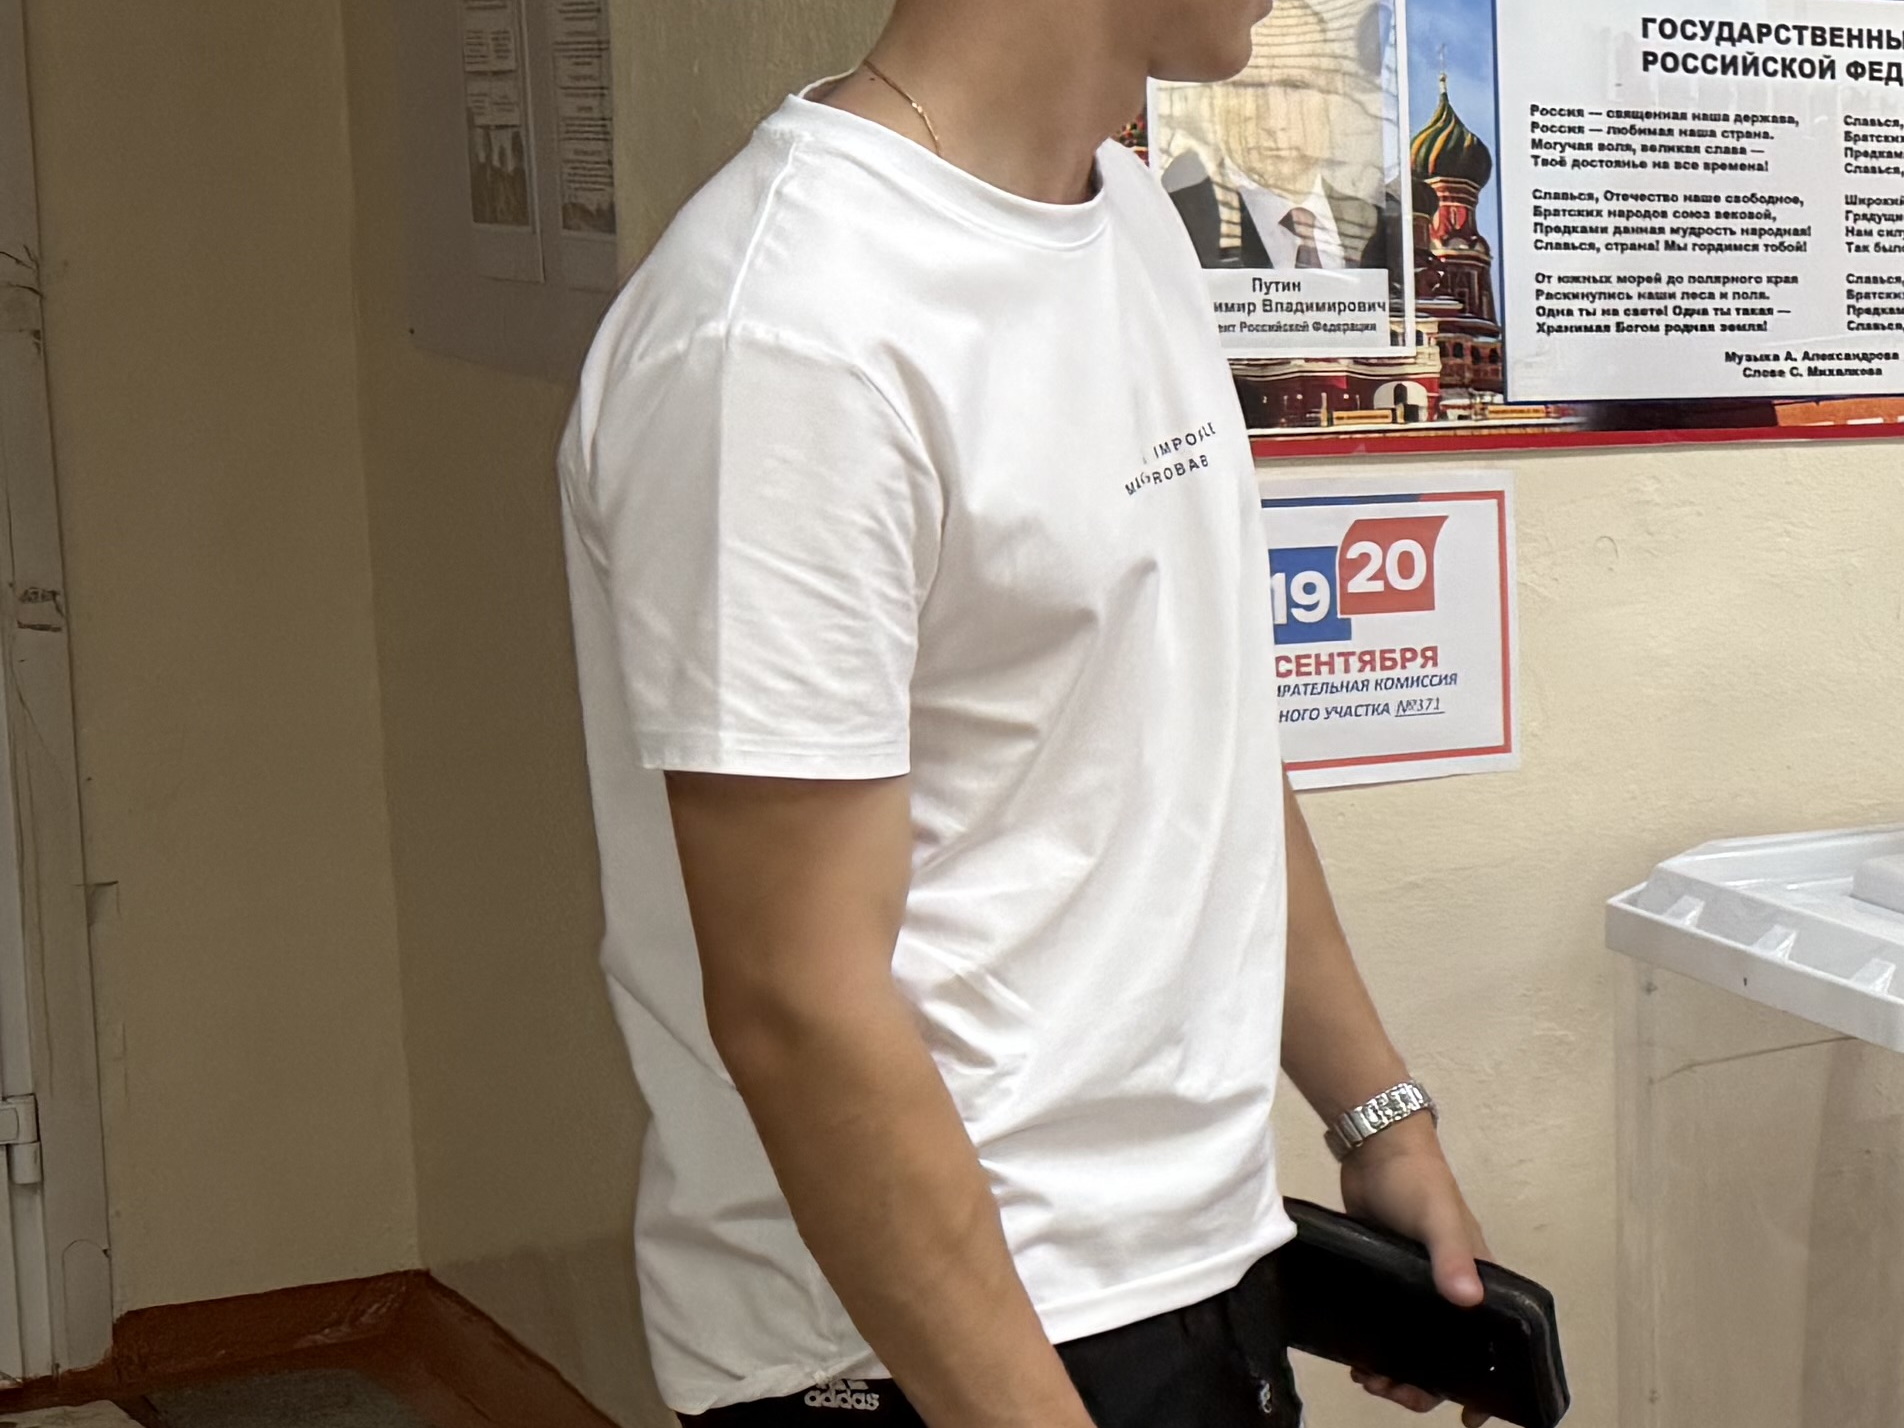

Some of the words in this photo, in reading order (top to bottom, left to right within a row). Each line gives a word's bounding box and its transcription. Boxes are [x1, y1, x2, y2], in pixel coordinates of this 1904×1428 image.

[1641, 49, 1836, 80] РОССИЙСКОЙ
[1529, 154, 1568, 168] Твоё
[1570, 157, 1648, 171] достоянье
[1651, 160, 1670, 170] на
[1673, 160, 1700, 171] все
[1702, 159, 1769, 174] времена!
[1843, 161, 1904, 178] Славься,
[1531, 187, 1600, 205] Славься,
[1602, 189, 1679, 203] Отечество
[1682, 193, 1722, 204] наше
[1724, 191, 1804, 208] свободное,
[1844, 240, 1870, 253] Так
[1252, 277, 1302, 295] Путин
[1262, 298, 1387, 317] Владимирович
[1345, 538, 1428, 594] 20
[1271, 571, 1331, 625] 19
[1275, 645, 1439, 679] СЕНТЯБРЯ
[1374, 672, 1458, 692] КОМИССИЯ
[1324, 702, 1391, 721] УЧАСТКА
